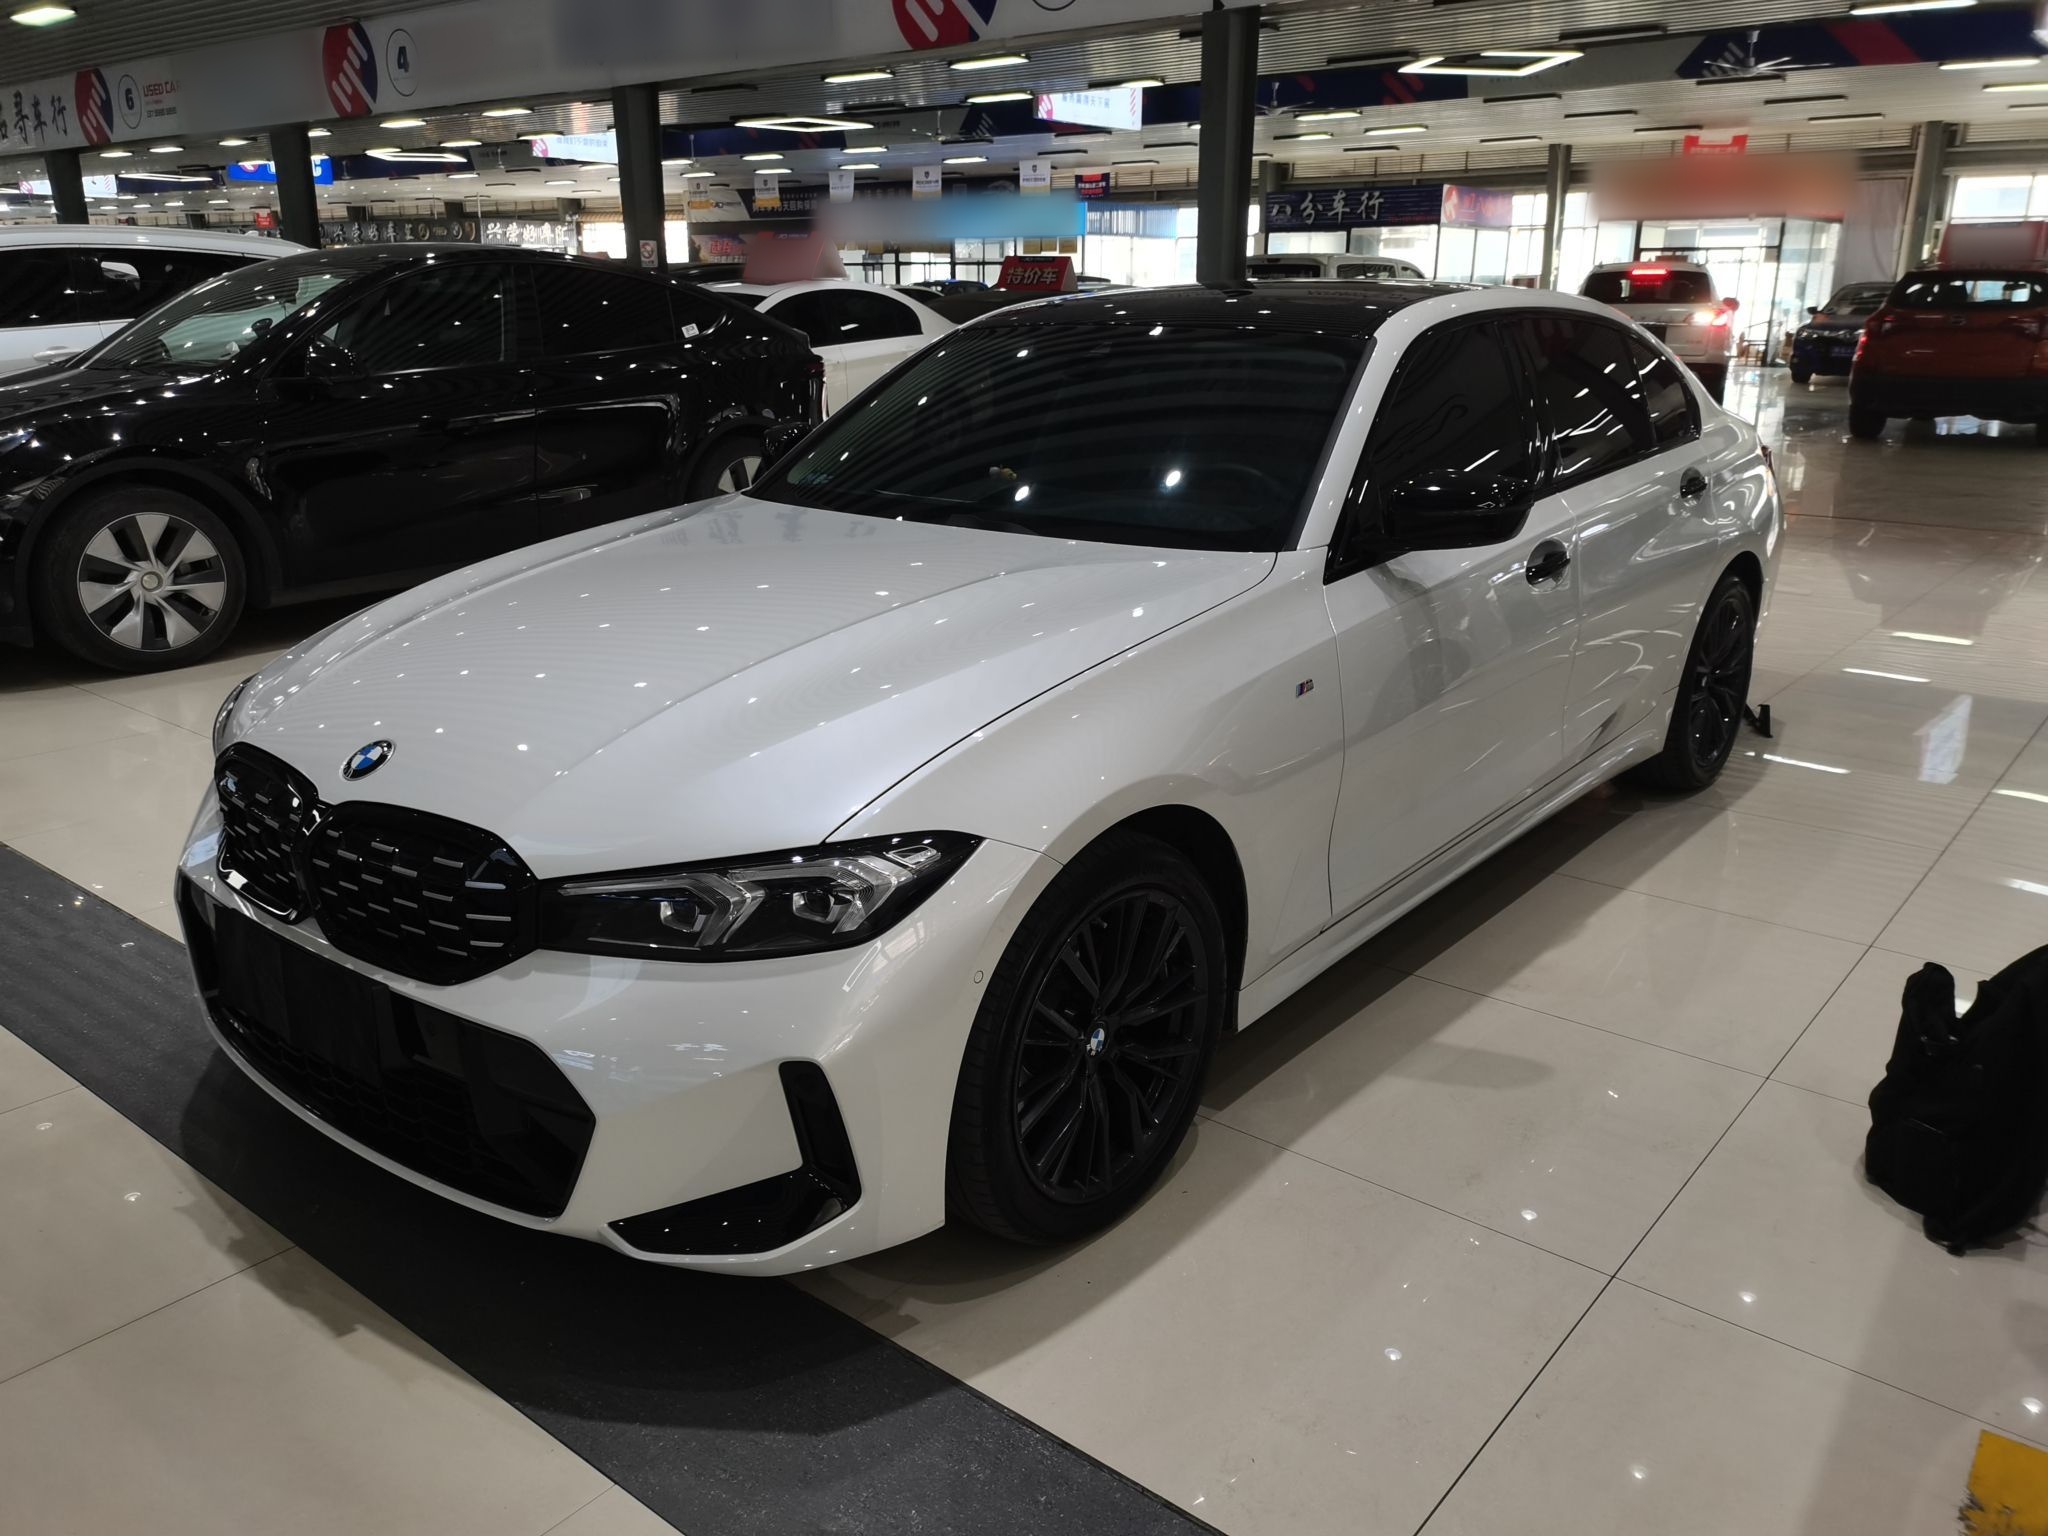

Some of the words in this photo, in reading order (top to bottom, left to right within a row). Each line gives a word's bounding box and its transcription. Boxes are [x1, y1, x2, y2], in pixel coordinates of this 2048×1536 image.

[397, 46, 409, 73] 4
[125, 88, 135, 111] 6
[143, 82, 164, 98] USED
[1006, 266, 1059, 284] 特价车
